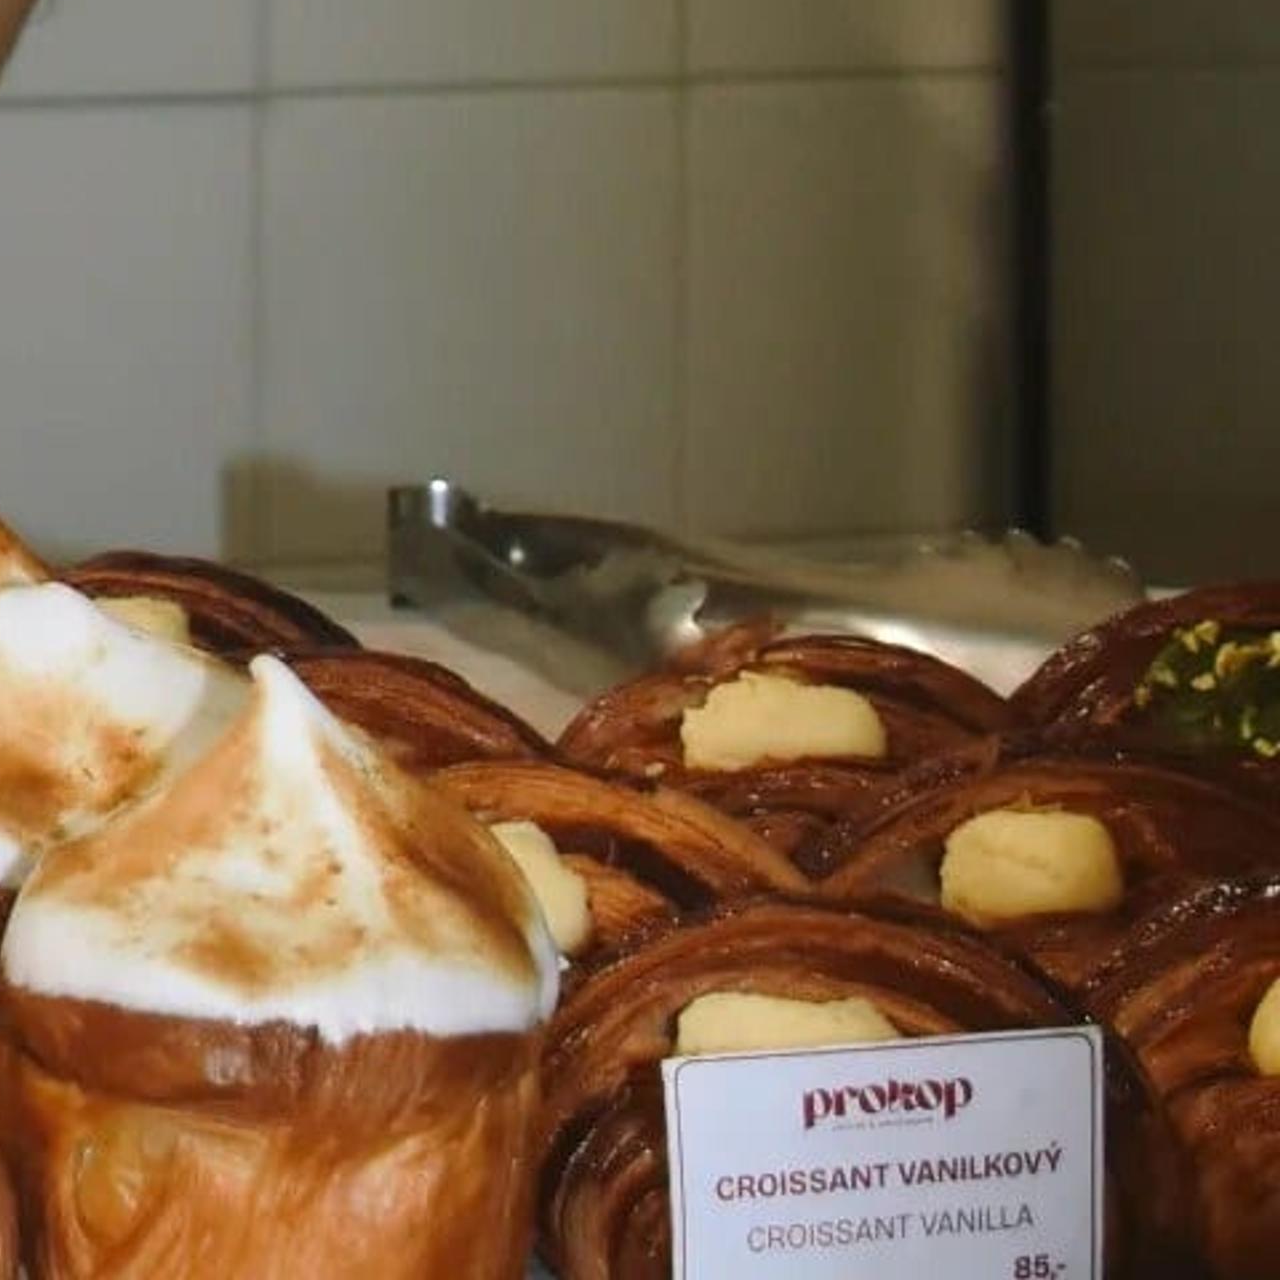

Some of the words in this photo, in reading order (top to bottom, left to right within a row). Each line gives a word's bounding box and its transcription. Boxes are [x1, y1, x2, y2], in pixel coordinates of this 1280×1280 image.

[801, 1075, 973, 1130] prokop
[716, 1164, 889, 1201] CROISSANT
[898, 1142, 1063, 1187] VANILKOVÝ
[747, 1216, 914, 1252] CROISSANT
[920, 1204, 1035, 1239] VANILLA
